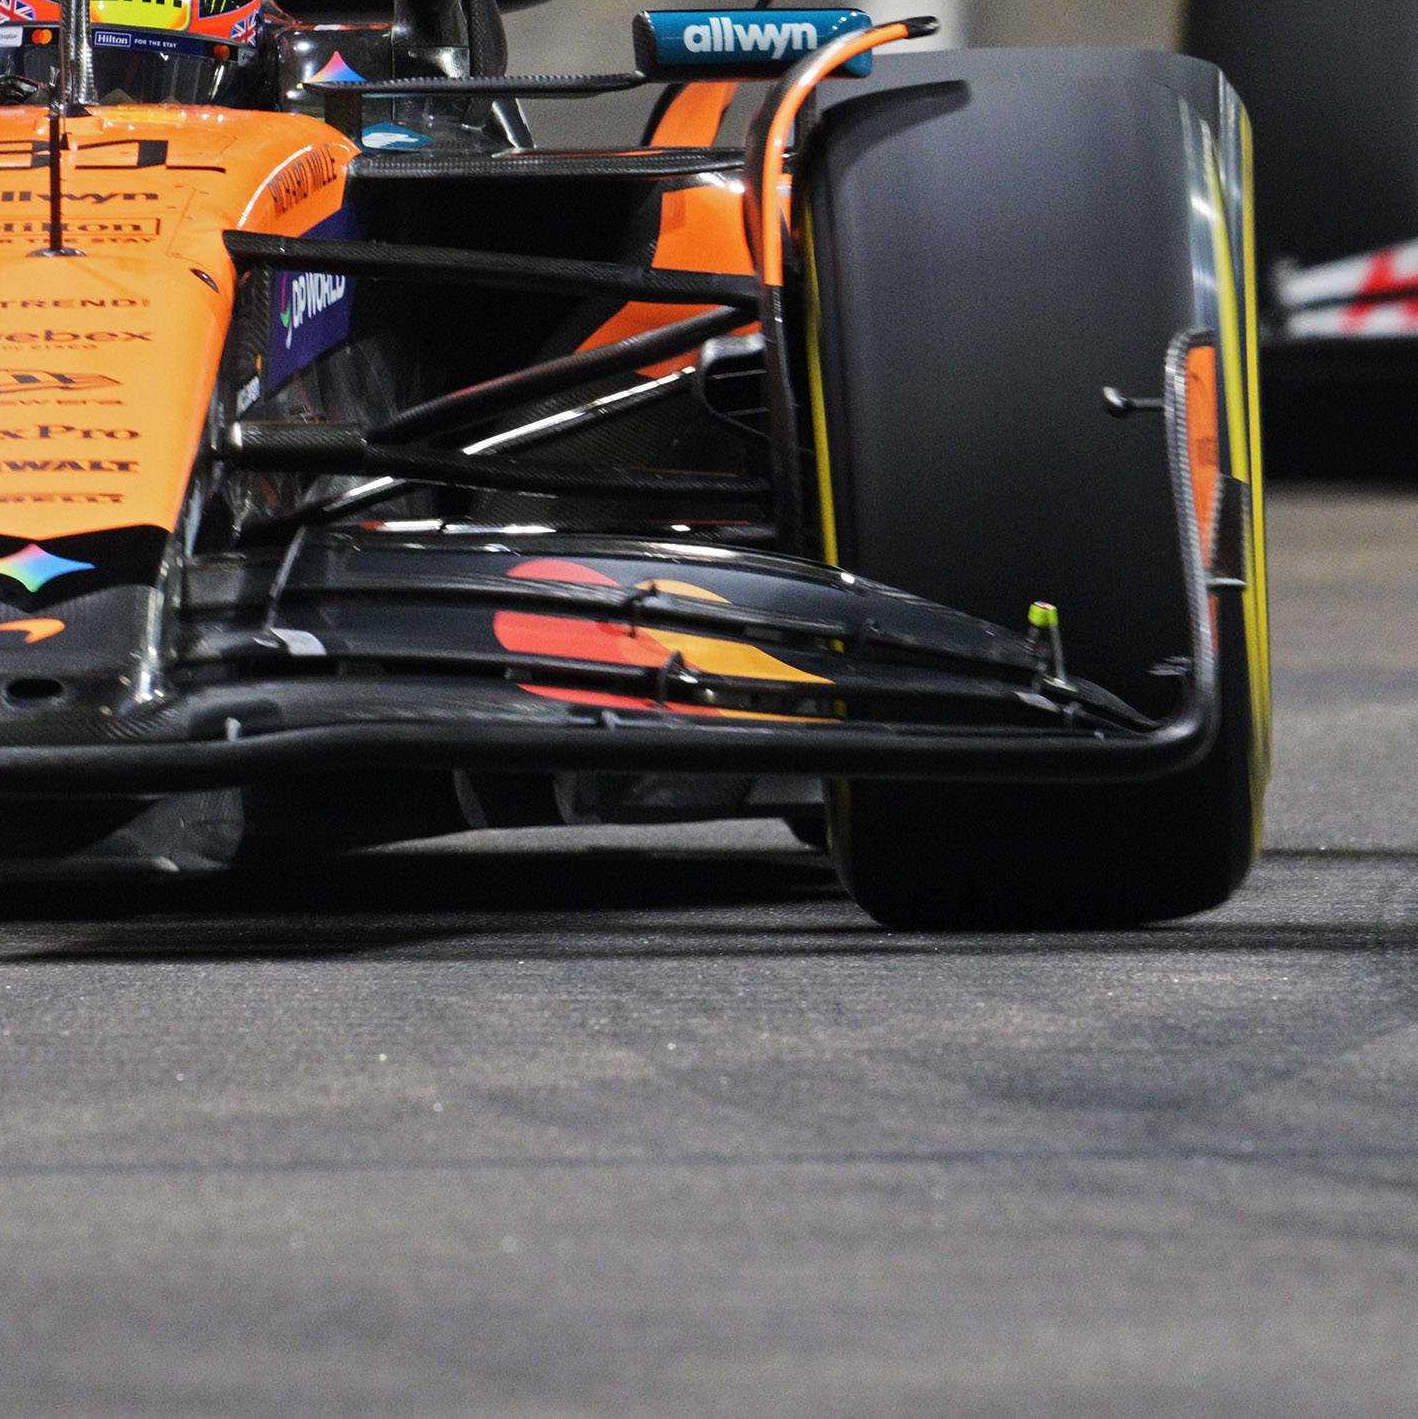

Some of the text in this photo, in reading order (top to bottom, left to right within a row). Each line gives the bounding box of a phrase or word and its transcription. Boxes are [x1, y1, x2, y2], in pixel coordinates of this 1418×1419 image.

[97, 34, 128, 45] Hilton
[162, 41, 177, 49] STAY
[683, 17, 818, 59] allwyn
